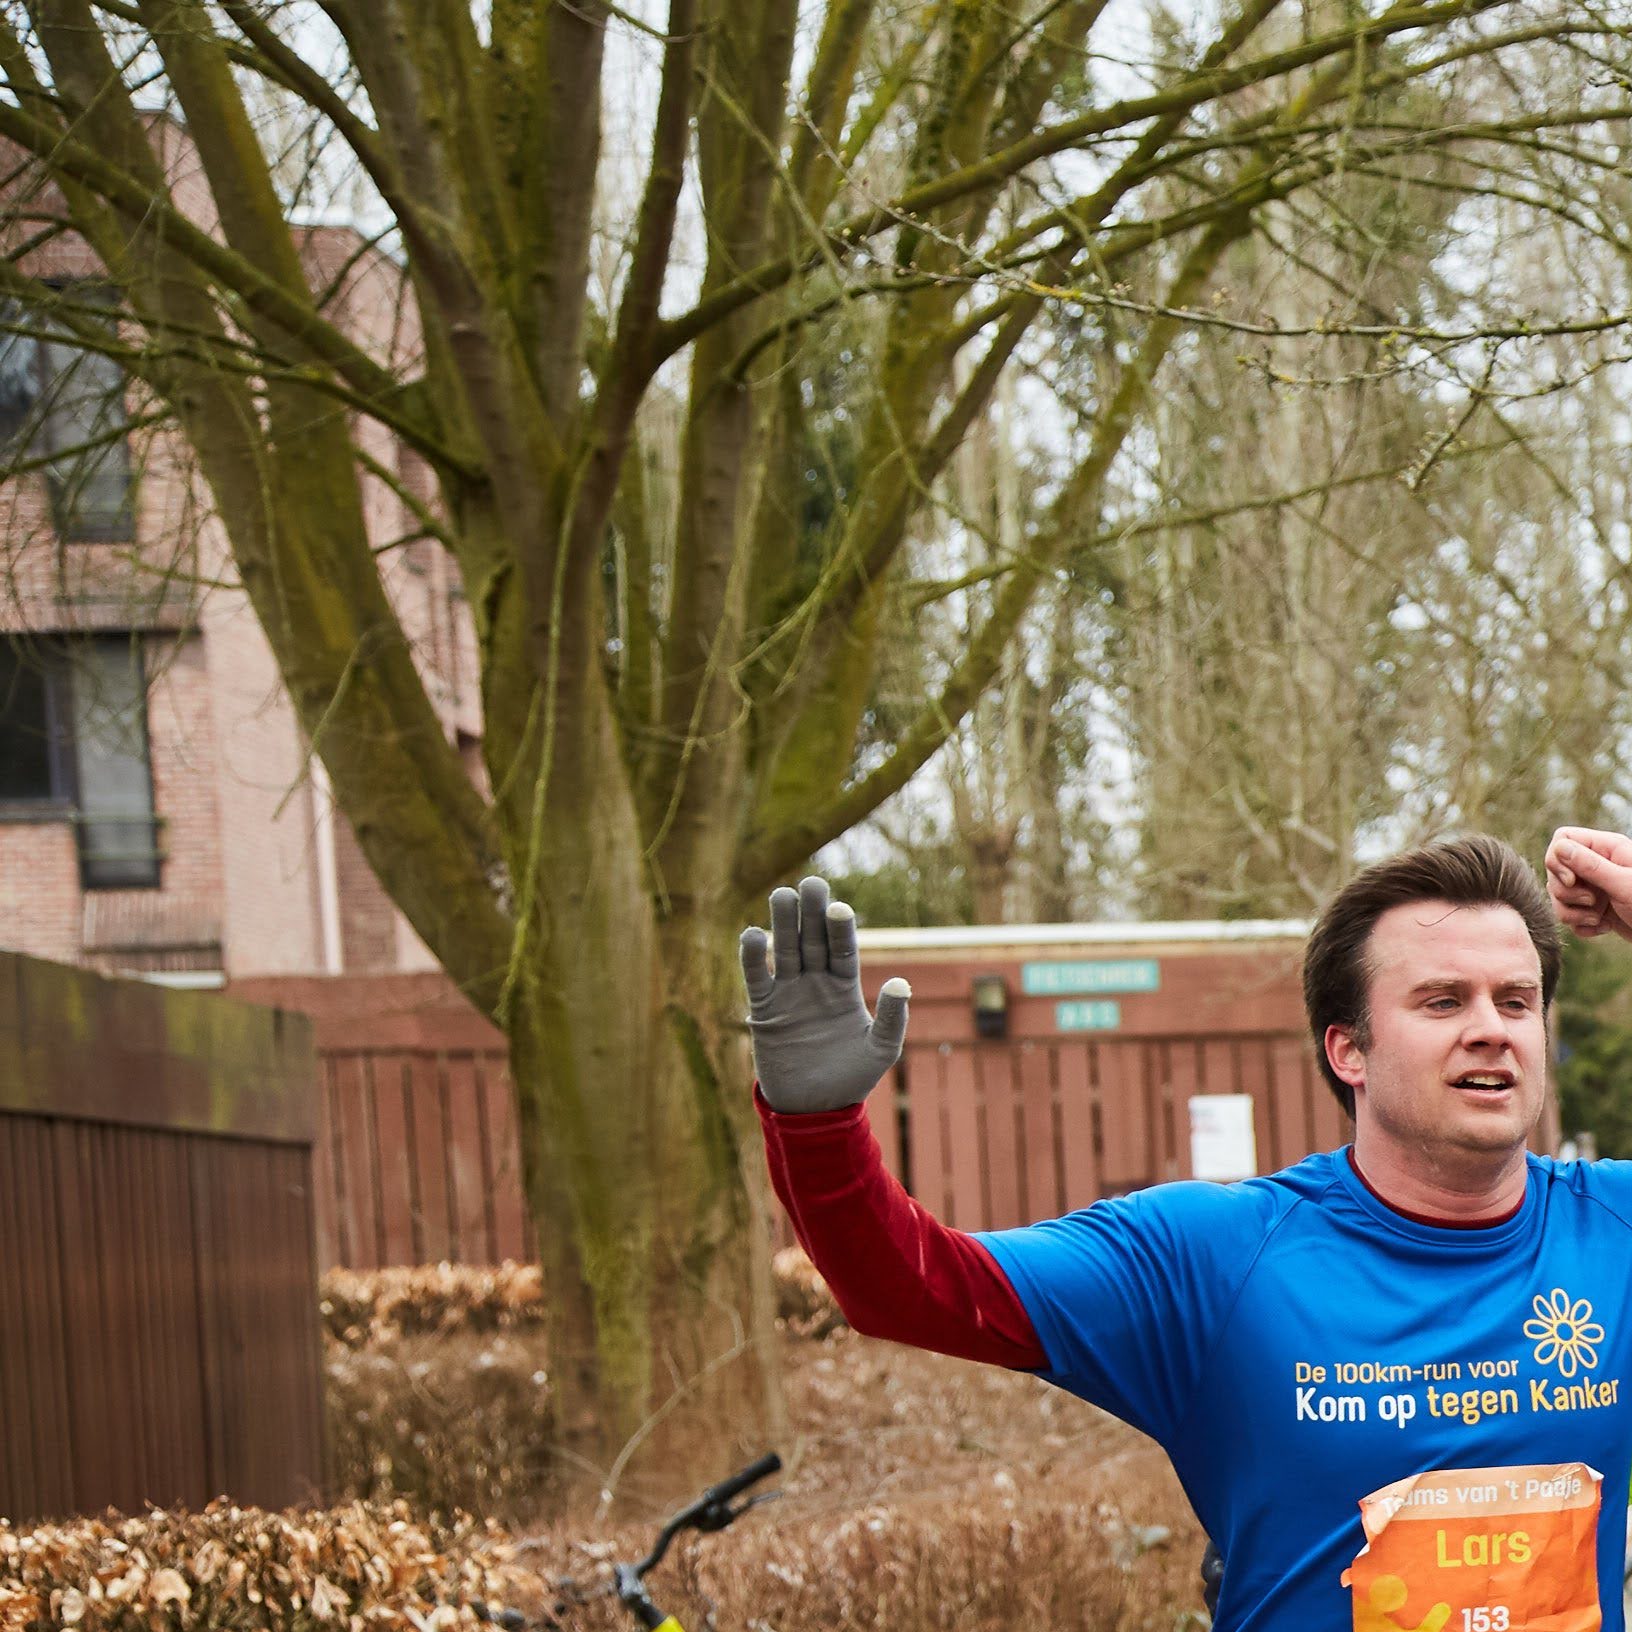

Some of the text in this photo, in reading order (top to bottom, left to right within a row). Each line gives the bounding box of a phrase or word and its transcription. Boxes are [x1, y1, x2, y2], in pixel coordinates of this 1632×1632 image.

[1295, 1359, 1520, 1385] De 100km-run voor
[1295, 1376, 1620, 1429] Kom op tegen Kanker
[1456, 1484, 1498, 1504] van
[1525, 1477, 1582, 1501] Padje
[1436, 1529, 1533, 1568] Lars
[1461, 1605, 1511, 1632] 153
